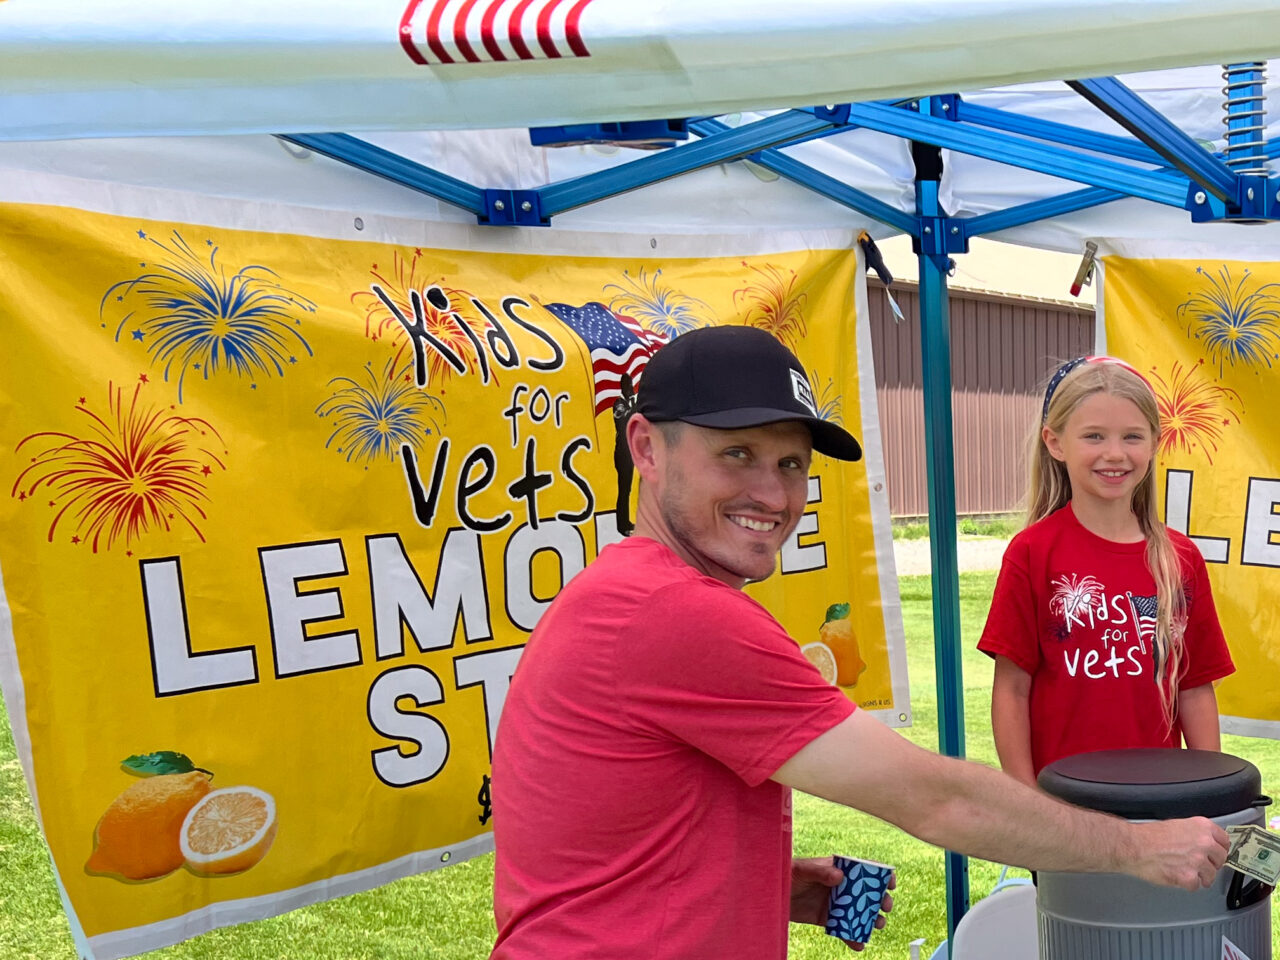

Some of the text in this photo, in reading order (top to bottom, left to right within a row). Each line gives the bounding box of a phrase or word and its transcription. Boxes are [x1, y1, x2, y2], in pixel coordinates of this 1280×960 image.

[371, 284, 565, 387] Kids
[503, 385, 570, 447] for
[1063, 593, 1128, 633] Kids
[1101, 629, 1129, 649] for
